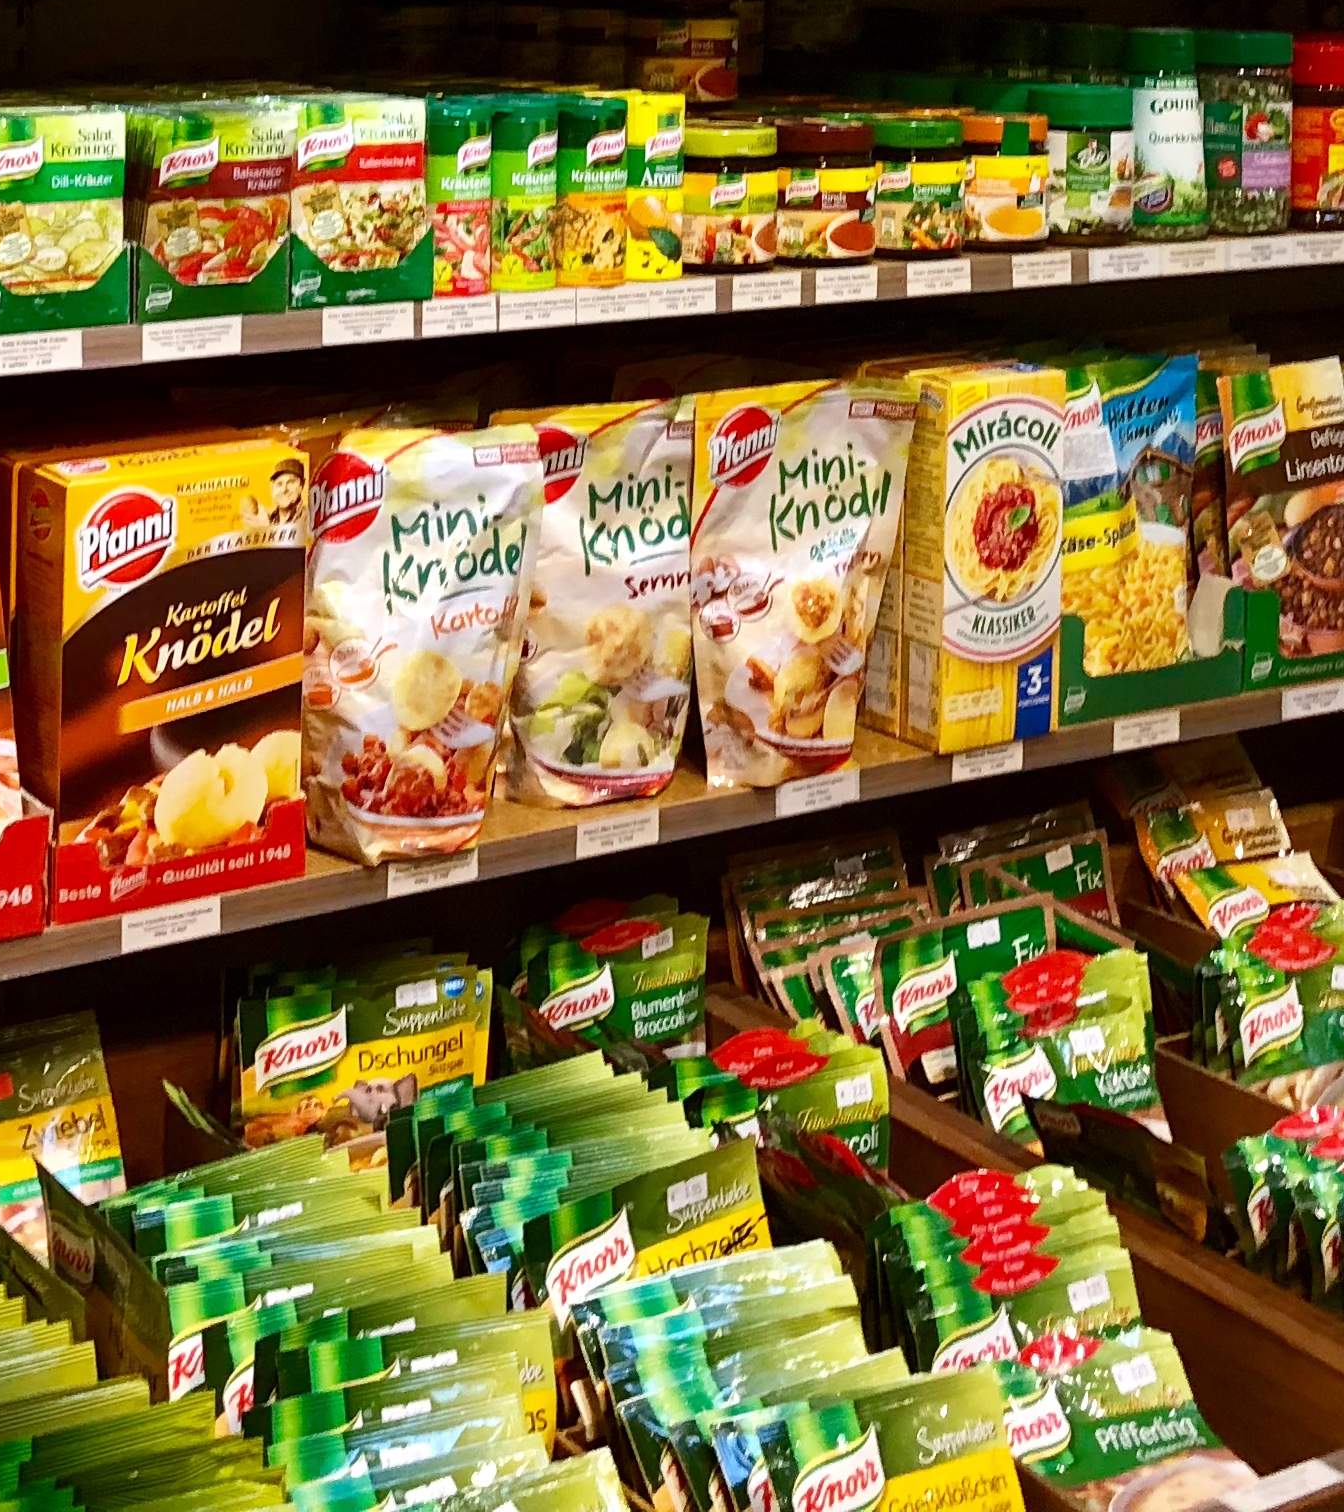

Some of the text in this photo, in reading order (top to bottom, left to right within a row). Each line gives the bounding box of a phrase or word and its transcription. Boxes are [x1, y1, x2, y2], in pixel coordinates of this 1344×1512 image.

[51, 141, 117, 159] Krönung
[710, 414, 779, 471] Pfanni
[952, 409, 1061, 465] Mirácoli
[1232, 418, 1283, 450] Knorr
[778, 442, 866, 494] Mini-
[588, 465, 685, 520] Mini-
[164, 586, 249, 628] Kartoffel
[971, 604, 1036, 635] KLASSIKER
[116, 597, 283, 686] Knödel
[1024, 664, 1043, 696] 3
[898, 970, 955, 1010] Knorr
[1244, 999, 1303, 1049] Knorr
[258, 1029, 343, 1074] Knorr
[356, 1031, 465, 1074] Dschungel
